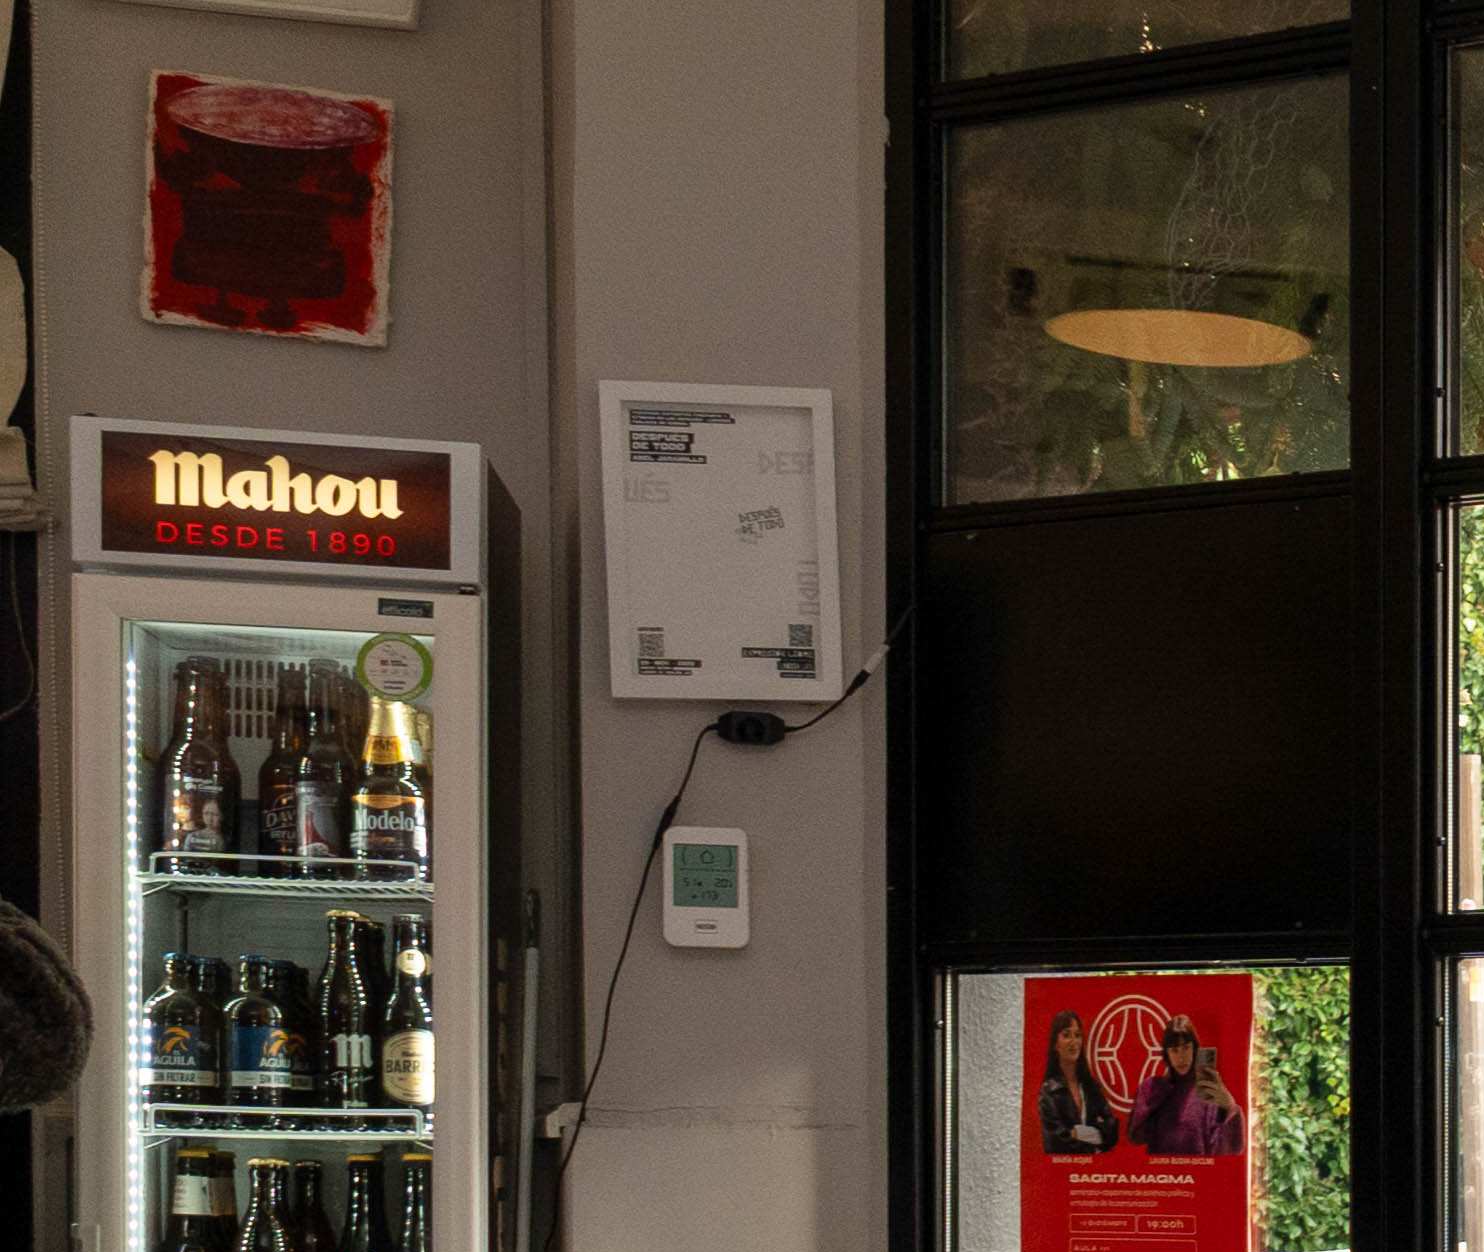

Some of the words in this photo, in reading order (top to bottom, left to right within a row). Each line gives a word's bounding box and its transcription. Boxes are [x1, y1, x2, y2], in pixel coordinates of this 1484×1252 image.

[148, 448, 405, 521] Mahou
[155, 521, 285, 551] DESDE
[306, 528, 397, 558] 1890
[355, 808, 415, 831] Modelo
[1068, 1173, 1129, 1184] SAGITA
[1130, 1174, 1196, 1185] MAGMA
